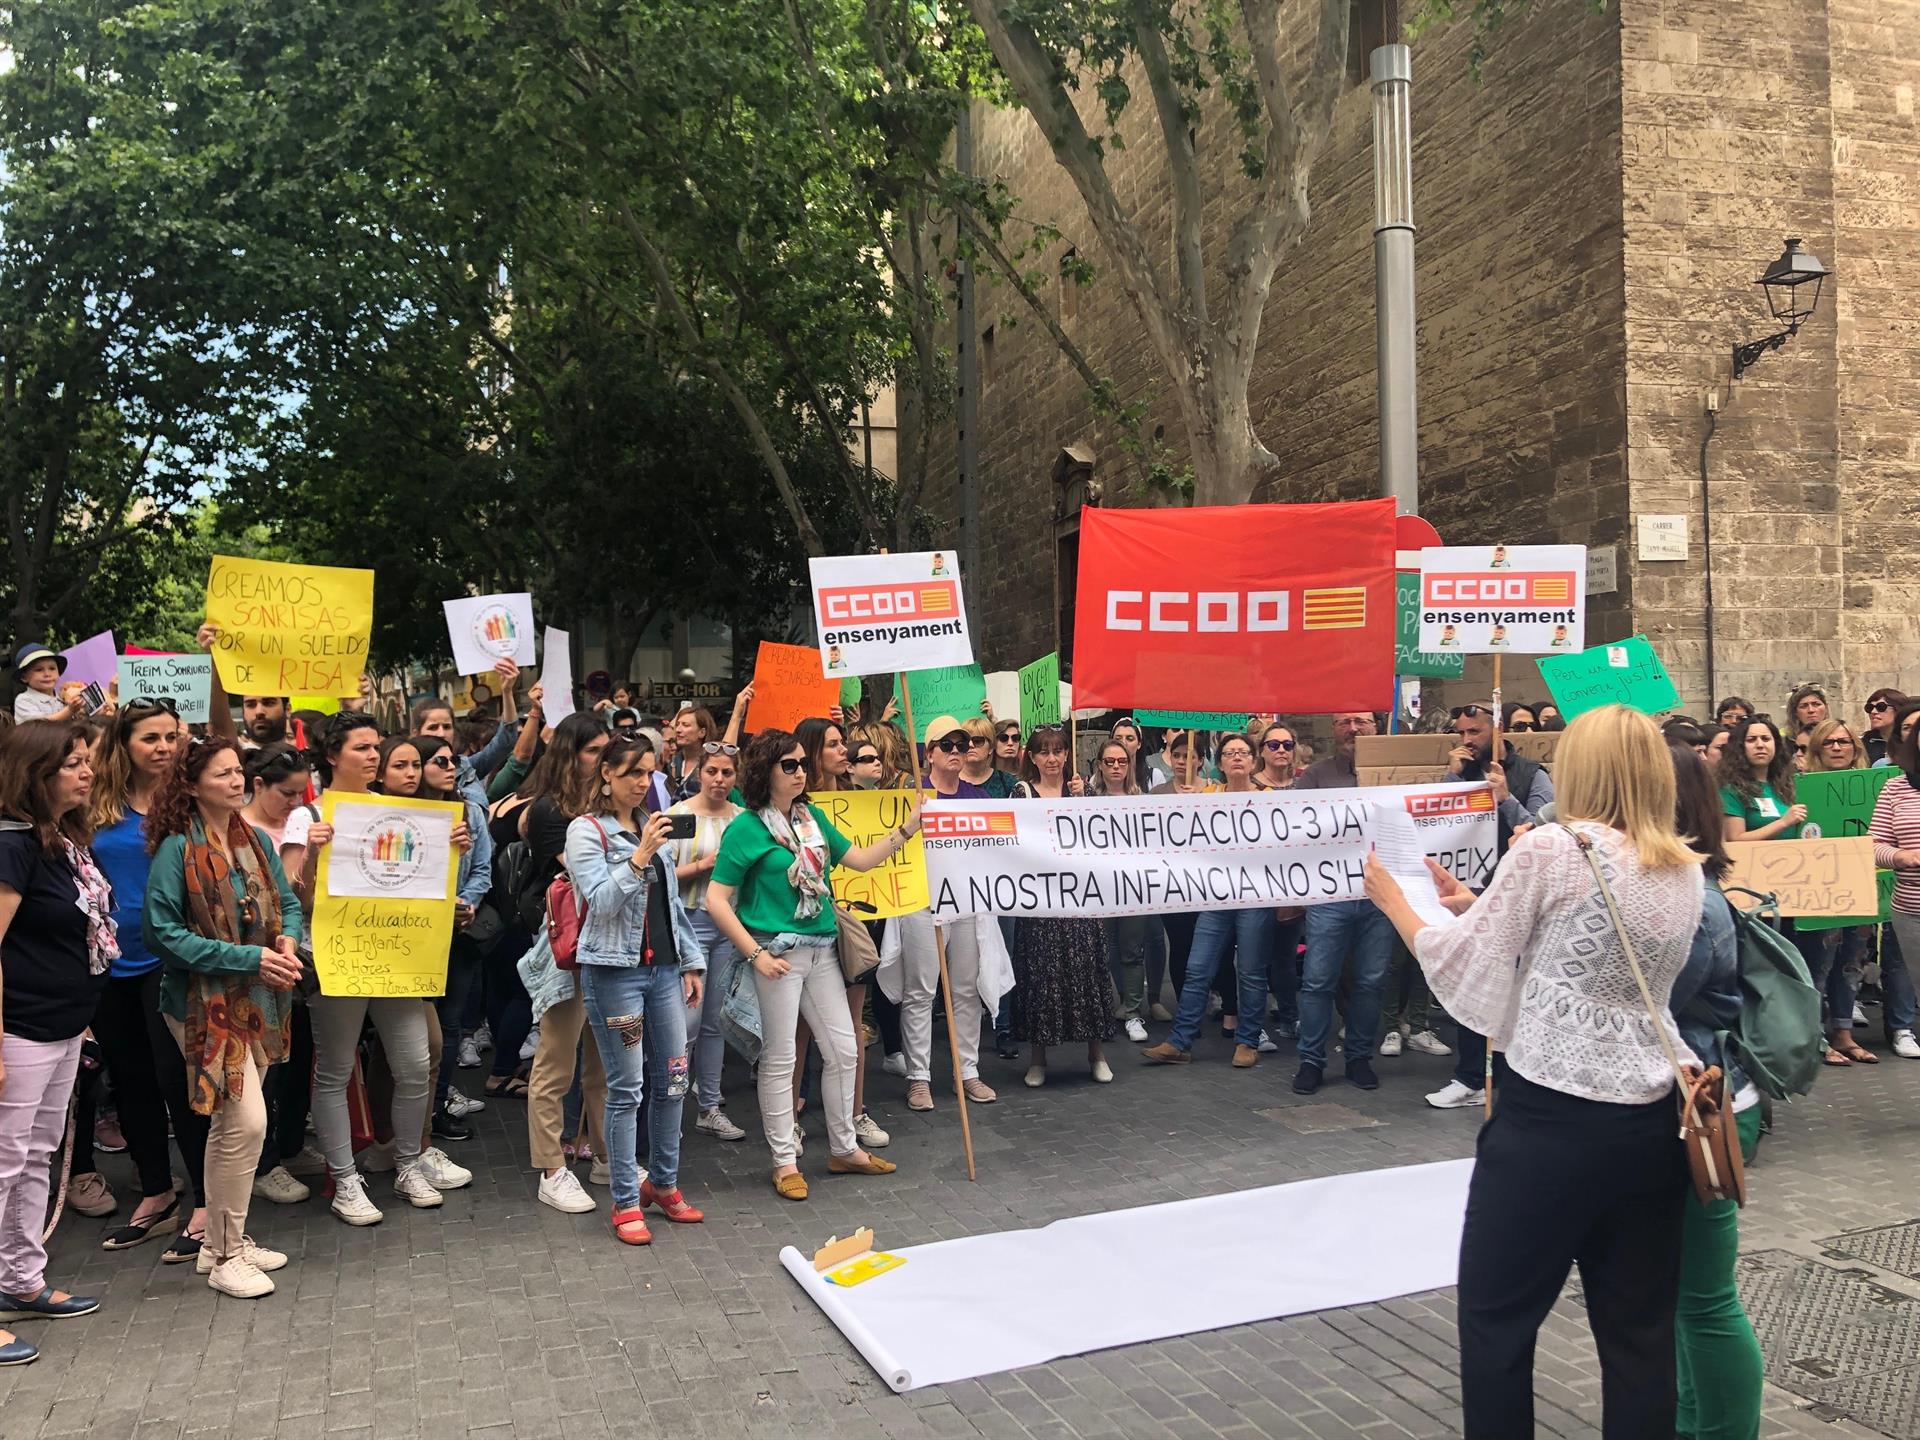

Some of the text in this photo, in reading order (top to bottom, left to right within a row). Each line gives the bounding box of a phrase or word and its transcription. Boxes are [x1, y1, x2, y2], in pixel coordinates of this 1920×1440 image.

[211, 564, 323, 606] CREAMOS
[1431, 579, 1527, 600] CCOO
[232, 601, 351, 632] SONRISAS
[826, 590, 916, 619] CCOO
[1106, 590, 1289, 632] CCOO
[1423, 608, 1576, 625] ensenyament
[214, 629, 368, 656] POR UN SUELDO
[824, 619, 962, 645] ensenyament
[235, 658, 344, 691] DE RISA
[1411, 795, 1468, 814] CCOO
[1413, 810, 1496, 828] nsenyament
[1055, 800, 1262, 850] DIGNIFICACIÓ
[1271, 806, 1322, 841] 0-3
[923, 835, 1020, 851] nsenyament
[1759, 843, 1841, 887] 21
[831, 870, 918, 911] IGNE
[931, 877, 960, 915] A
[969, 870, 1105, 913] NOSTRA
[1113, 859, 1261, 906] INFÀNCIA
[1264, 860, 1310, 898] NO
[1318, 859, 1366, 895] S'H
[1427, 846, 1494, 883] REIX
[332, 901, 433, 929] 1 Educadora
[324, 932, 412, 961] 18 Infants
[327, 957, 391, 976] 38 Hores
